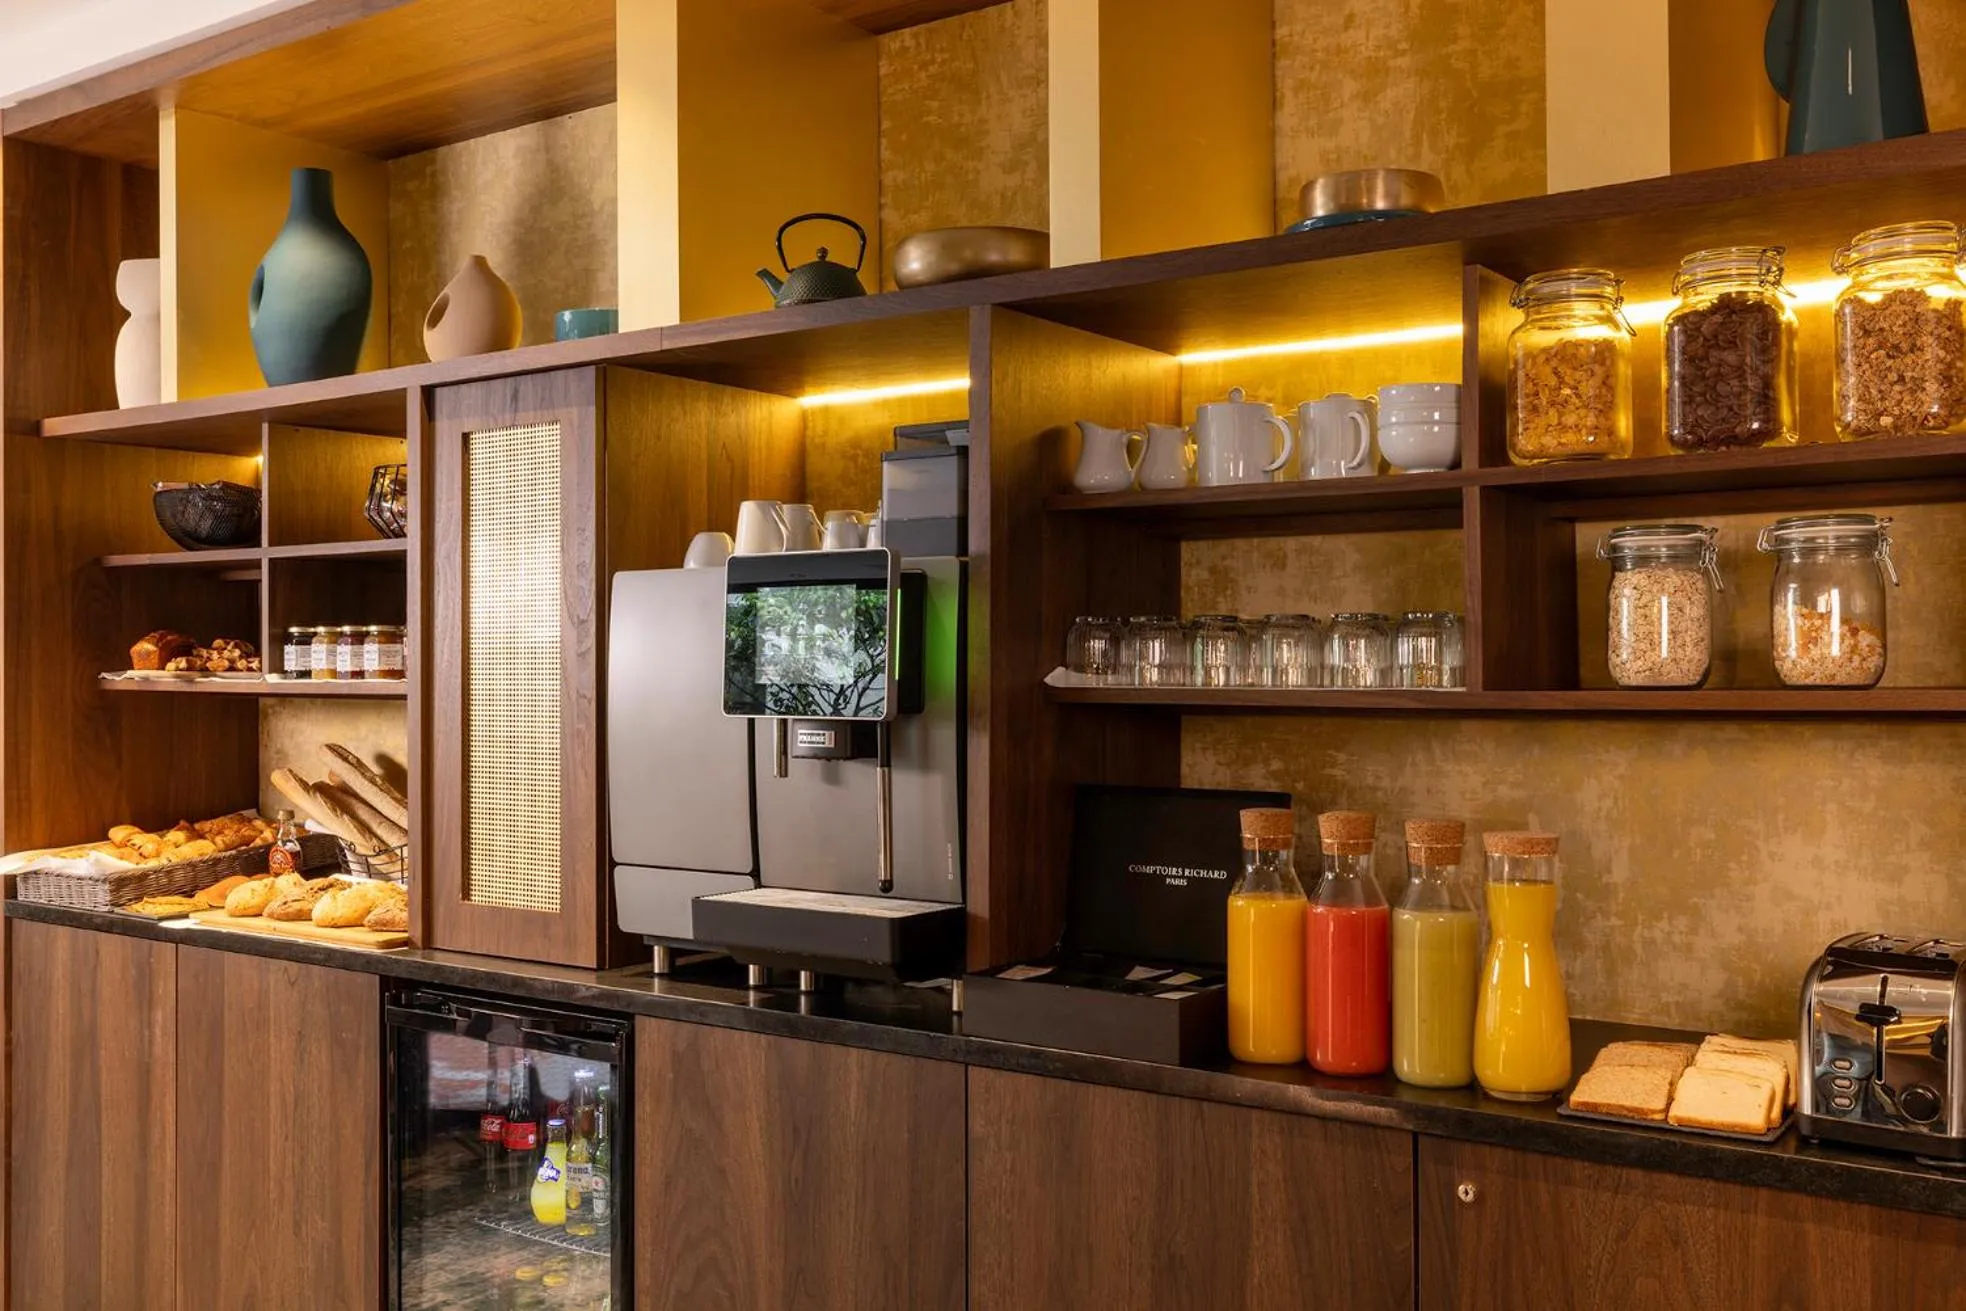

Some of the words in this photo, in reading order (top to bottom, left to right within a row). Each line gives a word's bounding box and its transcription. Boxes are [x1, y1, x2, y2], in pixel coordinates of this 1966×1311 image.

[1128, 864, 1183, 876] COMPTOIRS
[1184, 868, 1228, 879] RICHARD
[1165, 878, 1187, 886] PARIS
